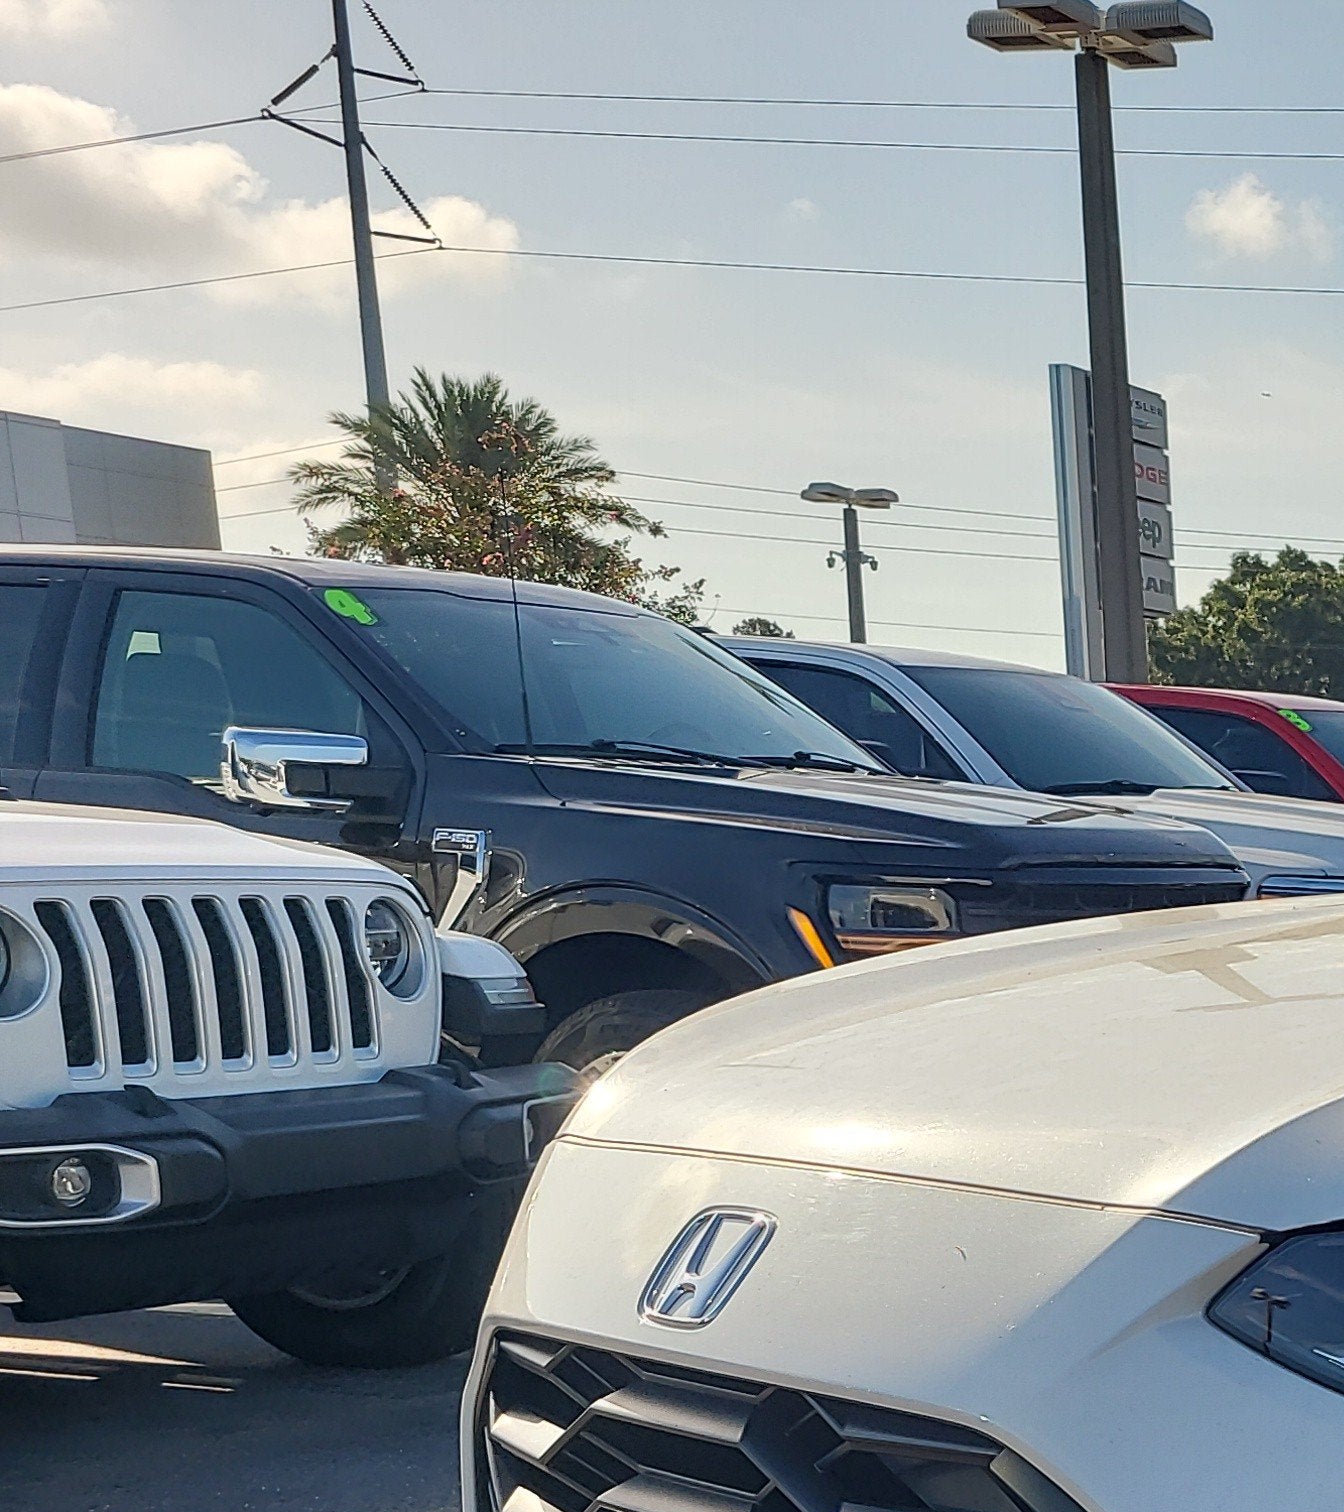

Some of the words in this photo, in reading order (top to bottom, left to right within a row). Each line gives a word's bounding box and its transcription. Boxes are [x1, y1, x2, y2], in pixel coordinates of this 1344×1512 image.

[1134, 462, 1168, 486] DGE
[1140, 517, 1162, 548] ep
[435, 832, 478, 844] F-150
